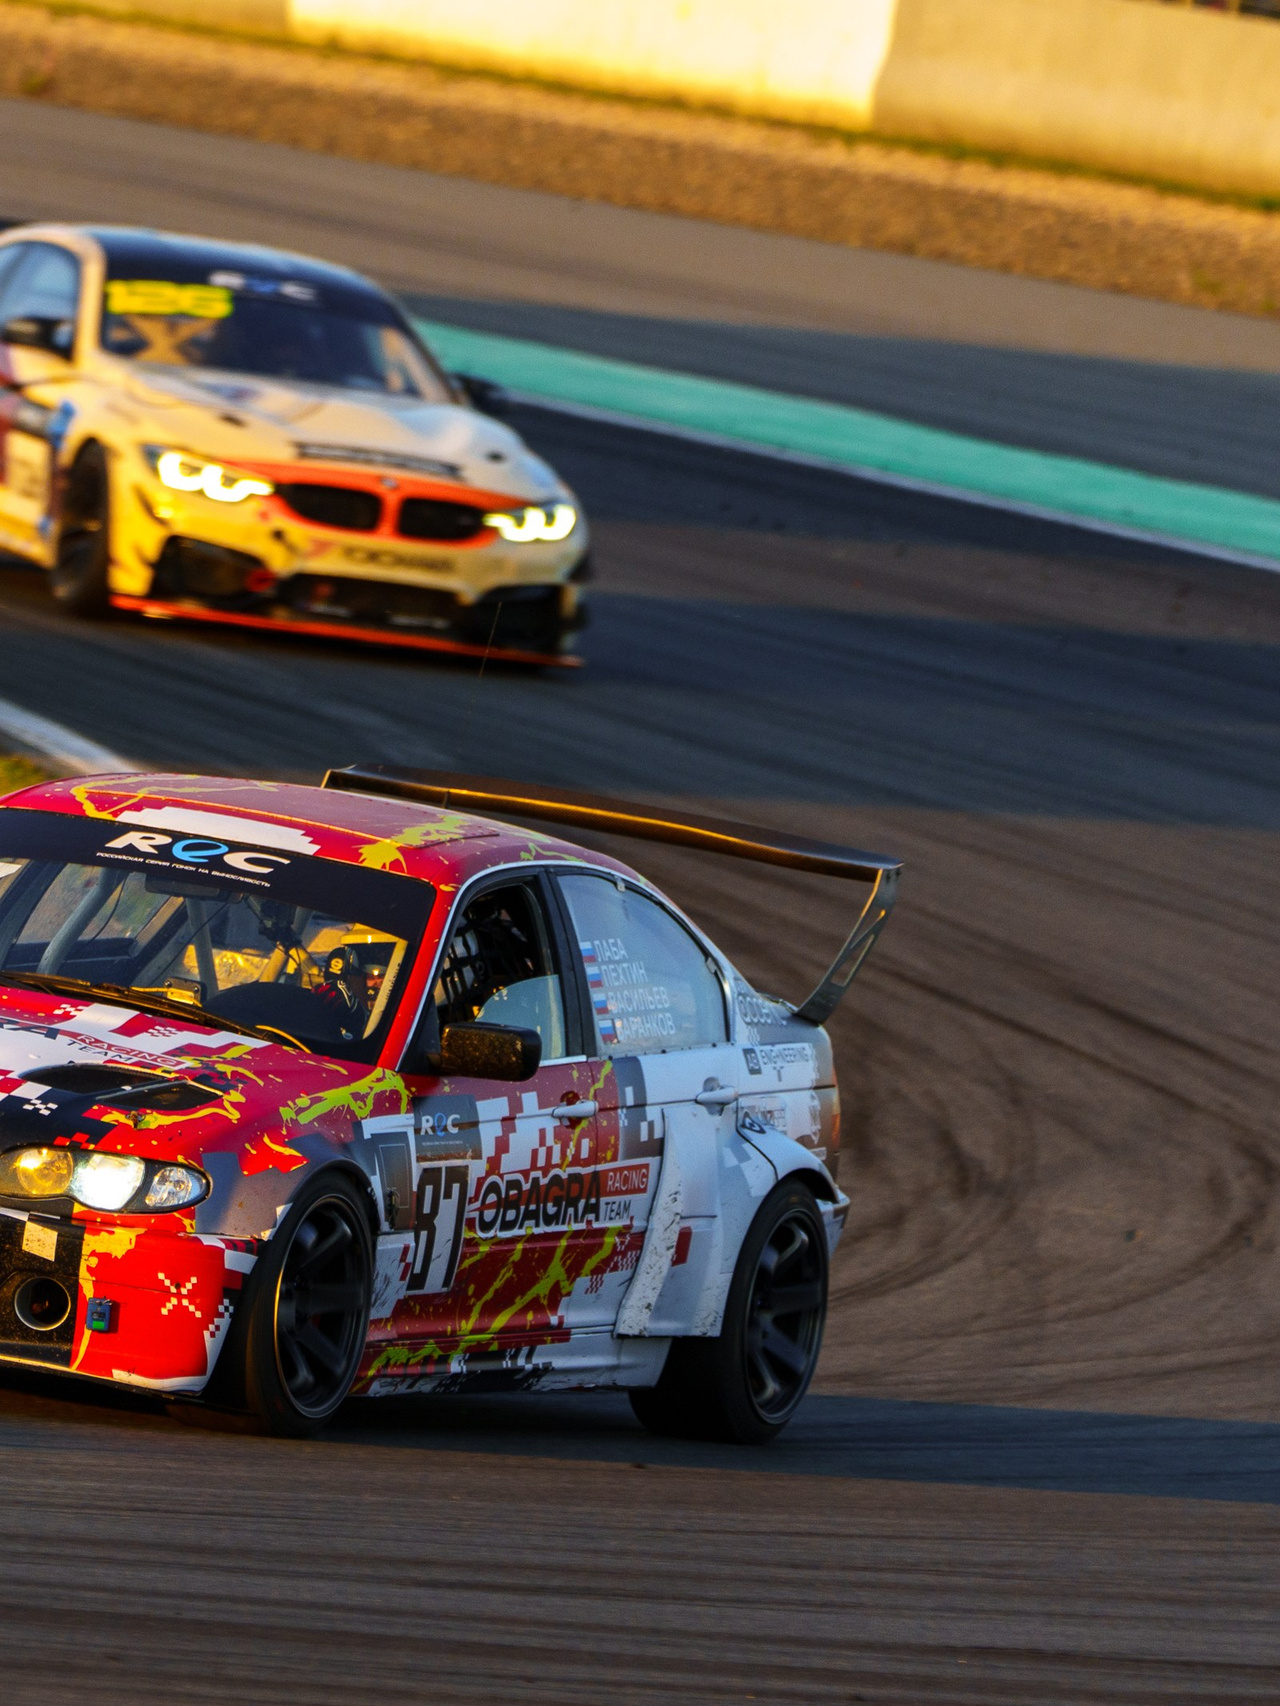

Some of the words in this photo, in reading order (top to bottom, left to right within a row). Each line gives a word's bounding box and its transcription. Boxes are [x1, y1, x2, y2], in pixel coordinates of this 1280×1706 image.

[66, 1040, 133, 1062] TEAM
[76, 1034, 177, 1066] RACING
[607, 1169, 647, 1192] RACING
[478, 1170, 601, 1233] OBAGRA
[604, 1200, 631, 1221] TEAM
[406, 1165, 469, 1292] 87
